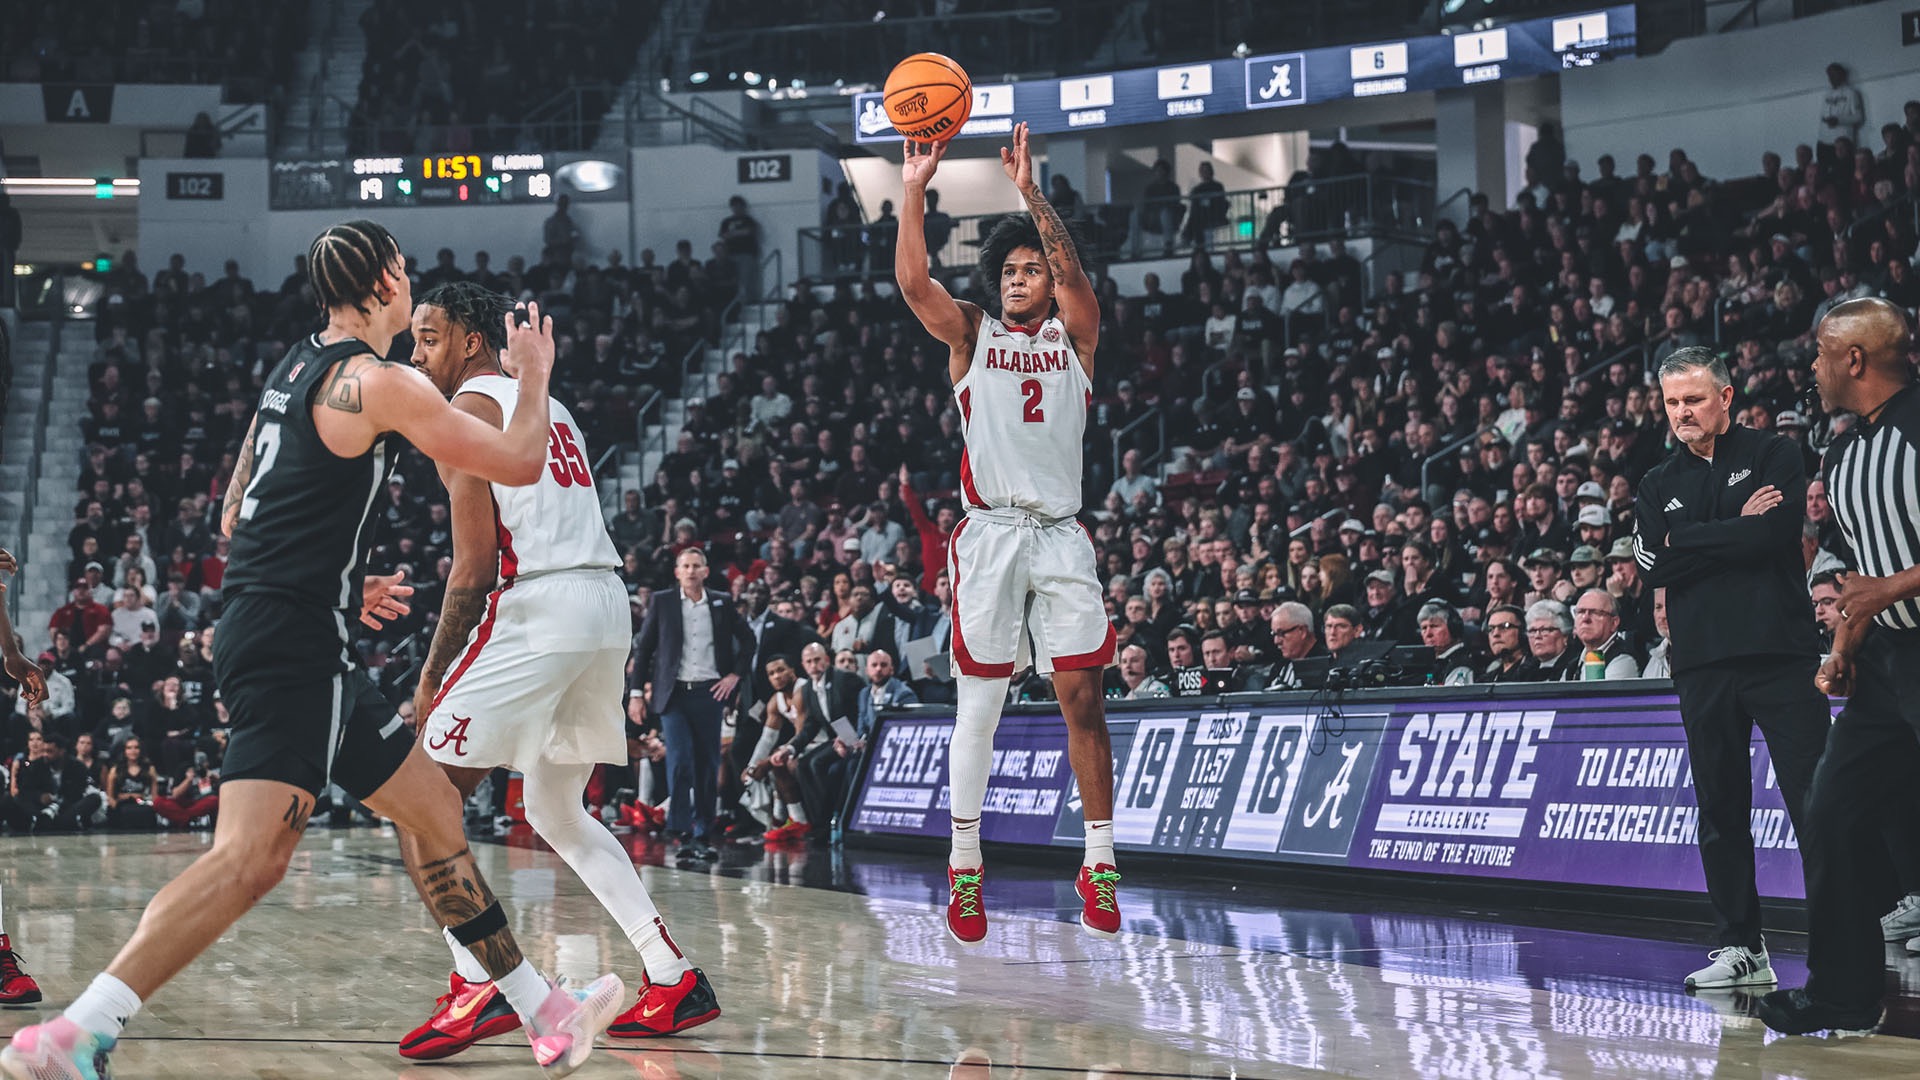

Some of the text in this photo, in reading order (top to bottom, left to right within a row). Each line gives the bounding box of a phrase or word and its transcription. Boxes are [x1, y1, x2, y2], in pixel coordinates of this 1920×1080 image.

[1374, 51, 1385, 69] 6
[1180, 73, 1190, 90] 2
[66, 89, 91, 118] A
[980, 92, 990, 109] 7
[423, 155, 482, 180] 11:57
[748, 160, 781, 179] 102
[179, 178, 212, 196] 102
[360, 177, 383, 200] 19
[397, 179, 412, 195] 4
[485, 176, 500, 193] 4
[986, 348, 1070, 373] ALABAMA
[1020, 379, 1045, 423] 2
[548, 422, 592, 488] 35
[239, 421, 282, 521] 2
[1178, 671, 1201, 690] POSS
[1207, 718, 1235, 740] POSS
[873, 725, 954, 784] STATE
[1188, 748, 1236, 784] 11:57
[1389, 711, 1557, 799] STATE
[1125, 727, 1176, 809] 19
[1246, 725, 1303, 814] 18
[1576, 748, 1602, 787] TO
[1606, 748, 1685, 788] LEARN
[1180, 787, 1199, 809] 1ST
[1199, 816, 1209, 834] 2
[1407, 810, 1490, 831] EXCELLENCE
[1369, 839, 1516, 867] THE FUND OF THE FUTURE
